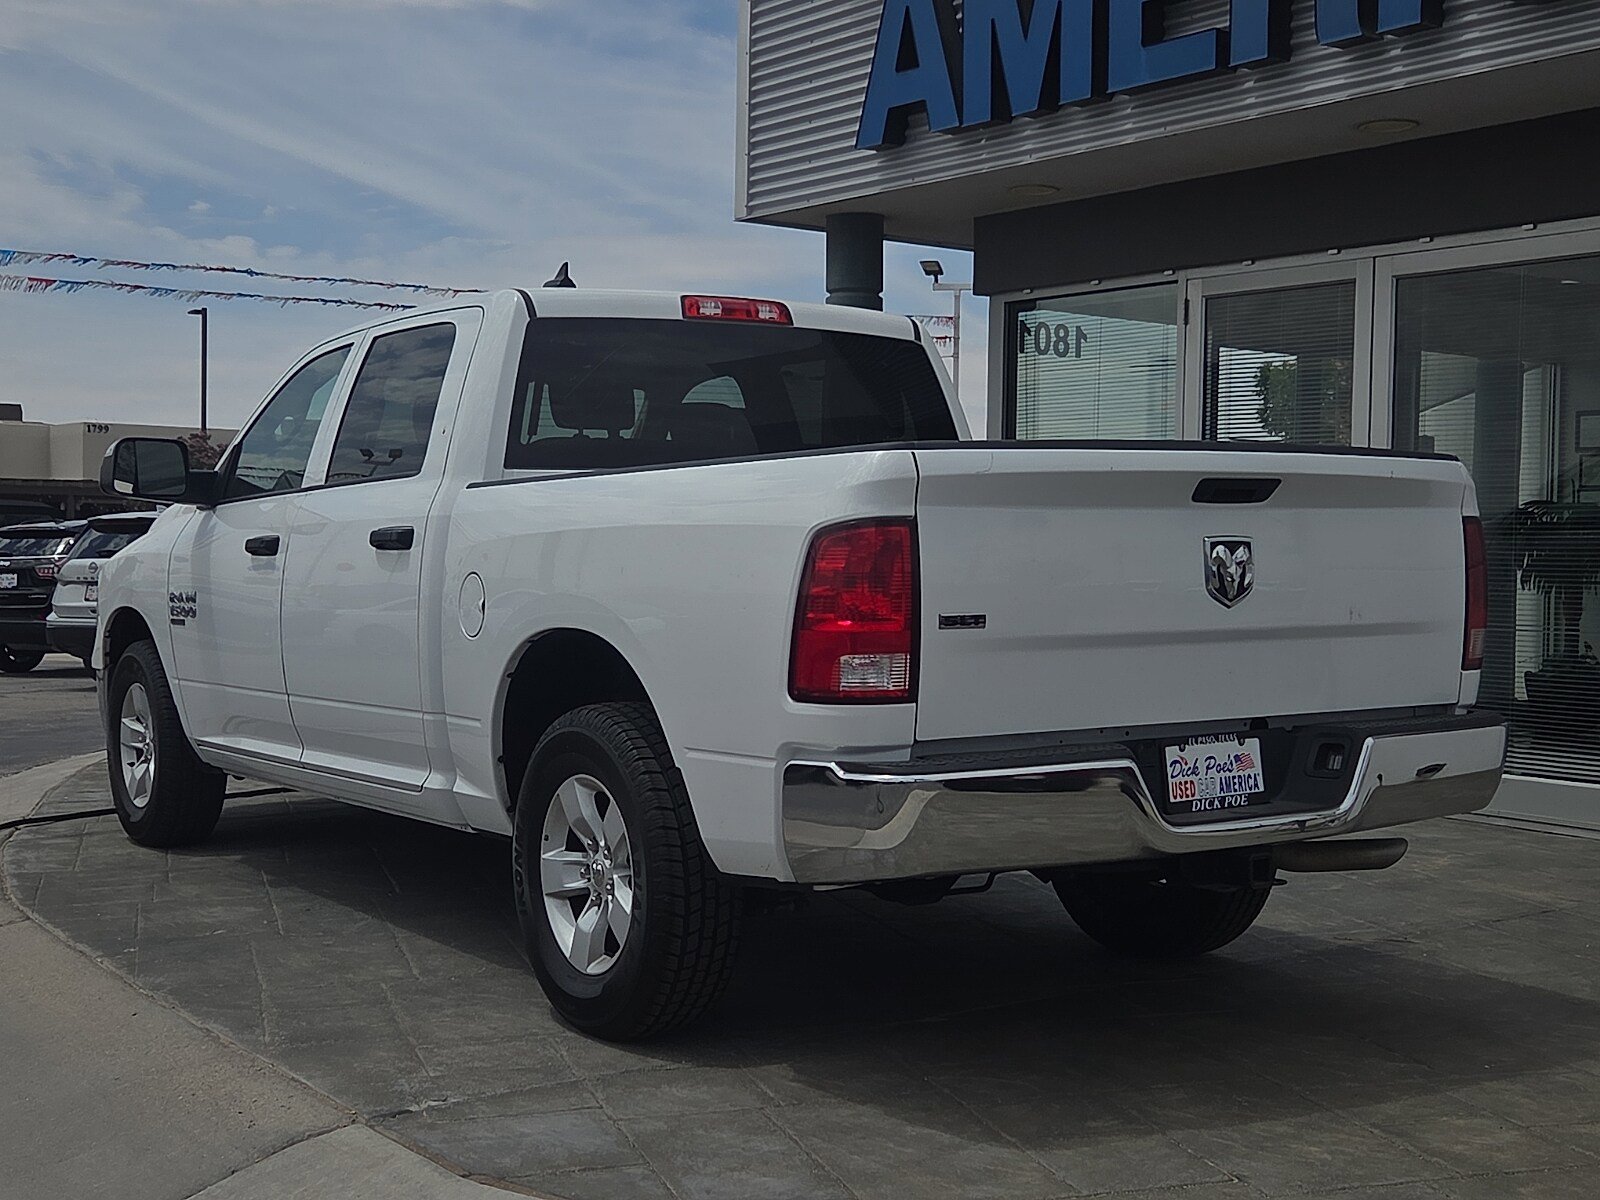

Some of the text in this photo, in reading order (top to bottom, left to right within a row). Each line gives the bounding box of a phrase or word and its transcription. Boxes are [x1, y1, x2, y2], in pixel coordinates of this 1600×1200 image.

[87, 424, 109, 433] 1799
[1169, 754, 1234, 779] Dick Poe's
[1171, 773, 1259, 800] USED CAR AMERICA
[1192, 794, 1249, 812] DICK POE
